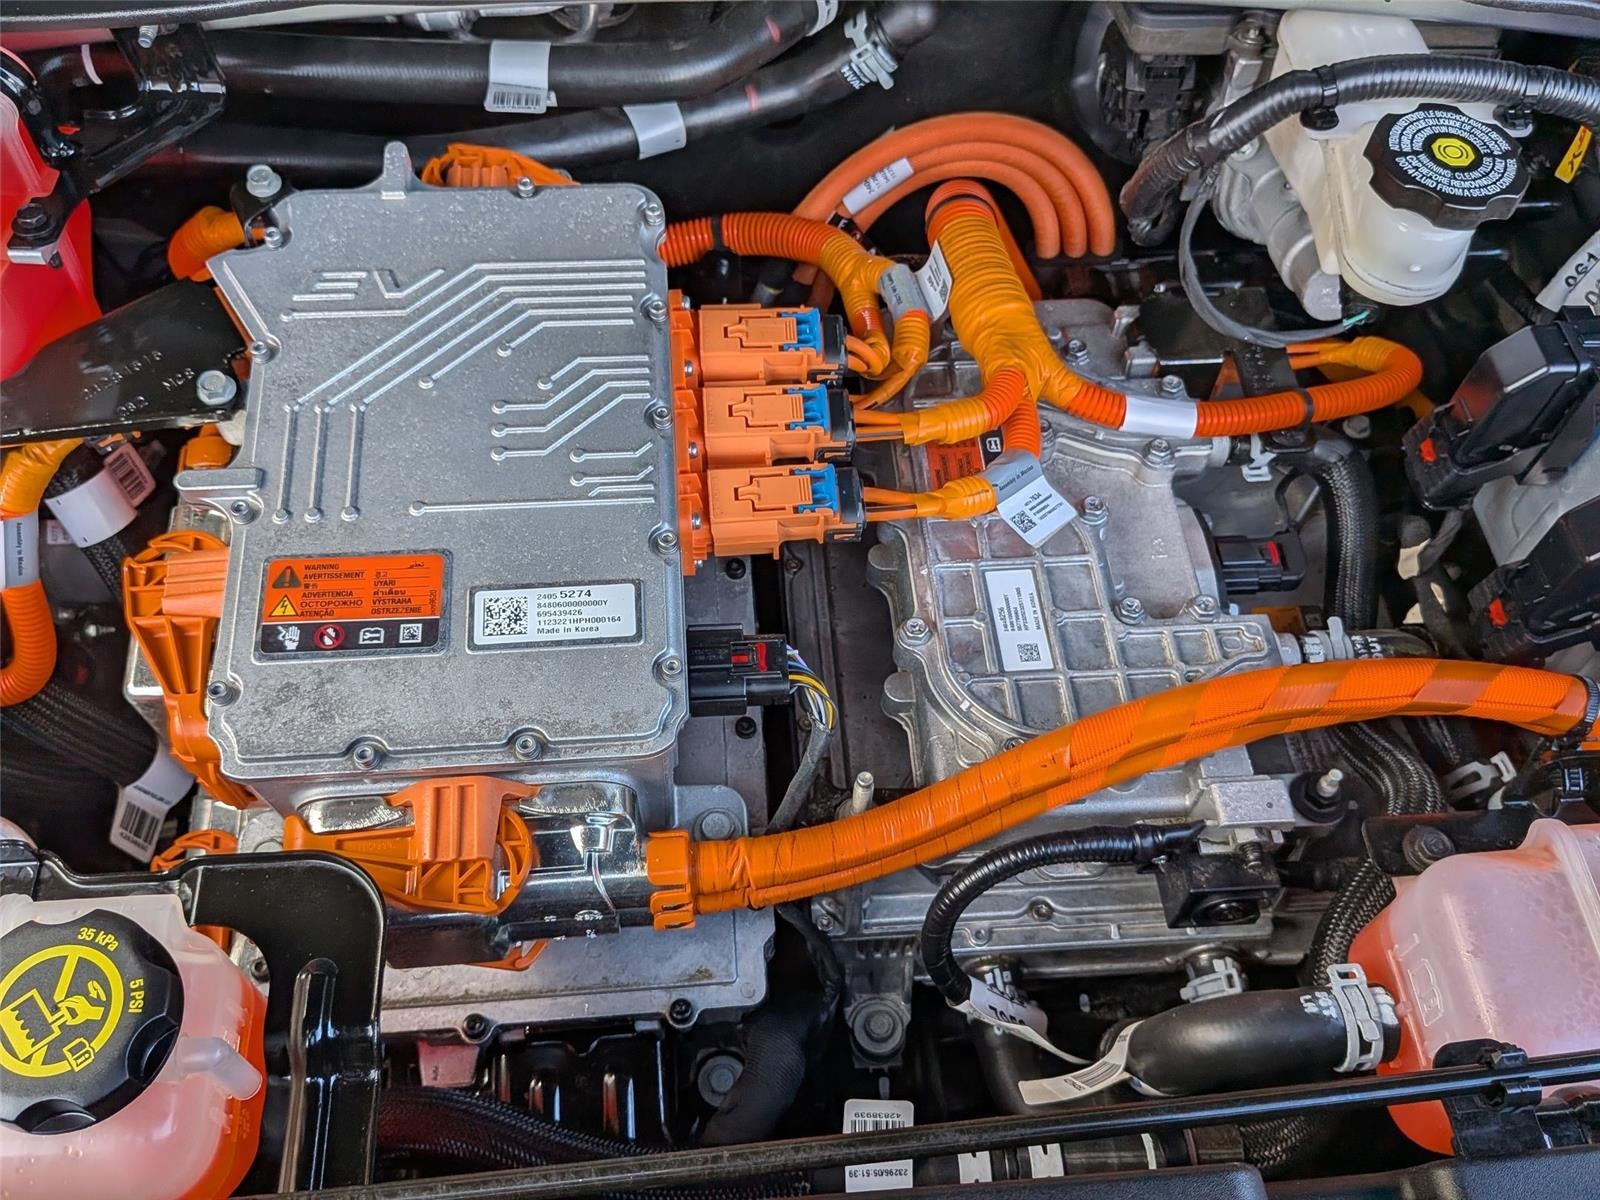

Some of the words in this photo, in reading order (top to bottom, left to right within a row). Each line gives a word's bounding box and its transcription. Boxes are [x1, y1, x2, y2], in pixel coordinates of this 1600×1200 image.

[1416, 165, 1450, 185] BEFORE
[1454, 169, 1483, 180] CLEAN
[1409, 170, 1437, 189] FLUID
[1435, 182, 1463, 196] FROM
[1462, 188, 1471, 197] A
[1469, 183, 1502, 197] SEALED
[304, 563, 340, 571] WARNING
[303, 571, 365, 580] AVERTISSEMENT
[301, 591, 354, 599] ADVERTENCIA
[536, 593, 558, 601] 2405
[559, 589, 592, 599] 5274
[300, 599, 364, 608] ОСТОРОЖНО
[299, 608, 335, 619] ATENÇÃO
[536, 609, 583, 618] 695439426
[536, 627, 560, 635] Made
[575, 625, 600, 633] Korea
[78, 927, 96, 940] 35
[96, 931, 119, 951] kPa
[129, 978, 144, 988] 5
[128, 991, 144, 1013] PSI
